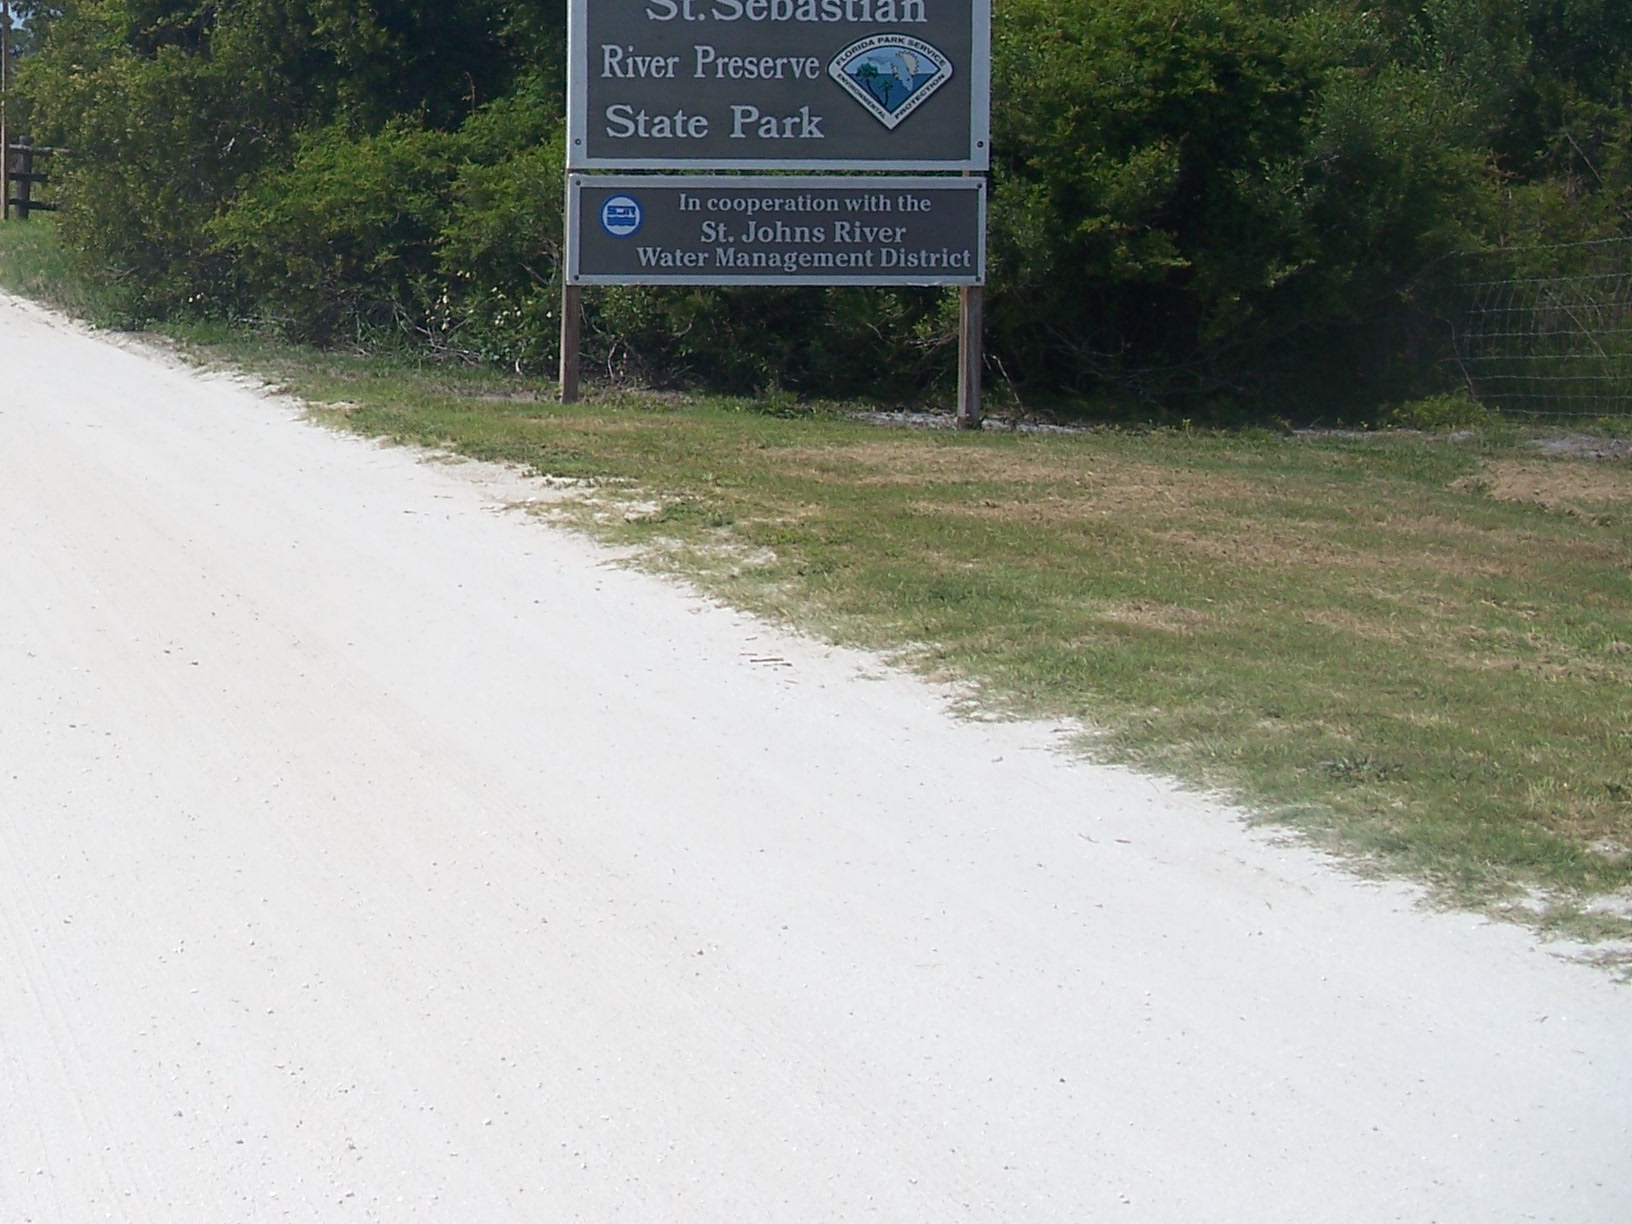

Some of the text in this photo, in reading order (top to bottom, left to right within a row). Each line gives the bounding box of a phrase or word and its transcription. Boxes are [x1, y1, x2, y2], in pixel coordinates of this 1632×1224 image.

[600, 44, 820, 79] River Preserve
[835, 36, 946, 67] FLORIDA PARK SERVICE
[836, 73, 945, 120] ENVIRONMENTAL PROTECTION
[605, 104, 825, 139] State Park
[679, 193, 931, 216] In cooperation with the
[700, 220, 907, 244] St. Johns River
[636, 246, 972, 272] Water Management District
